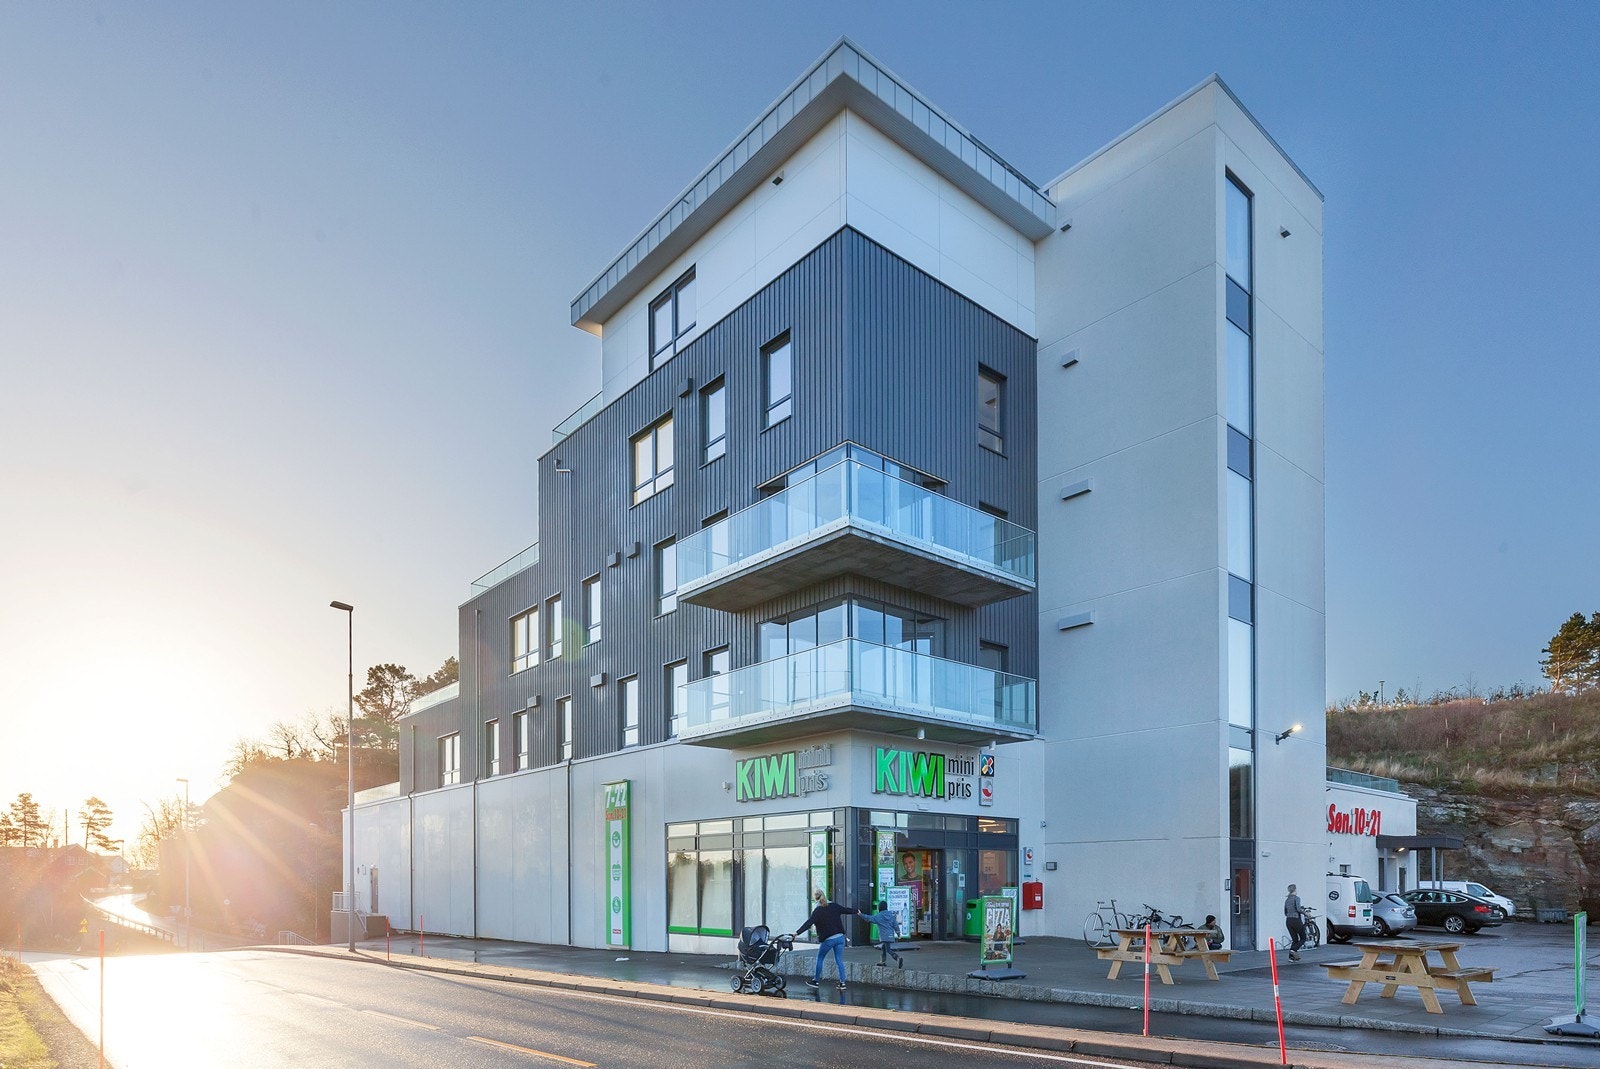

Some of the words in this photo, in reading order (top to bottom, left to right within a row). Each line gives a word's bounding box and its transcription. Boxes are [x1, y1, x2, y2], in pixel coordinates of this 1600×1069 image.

[736, 751, 796, 800] KIWI
[876, 747, 945, 796] KIWI
[948, 756, 975, 776] mini
[605, 782, 626, 808] 7-22
[948, 779, 972, 800] pris
[1328, 803, 1352, 833] Søn.
[1354, 808, 1381, 836] 10-21
